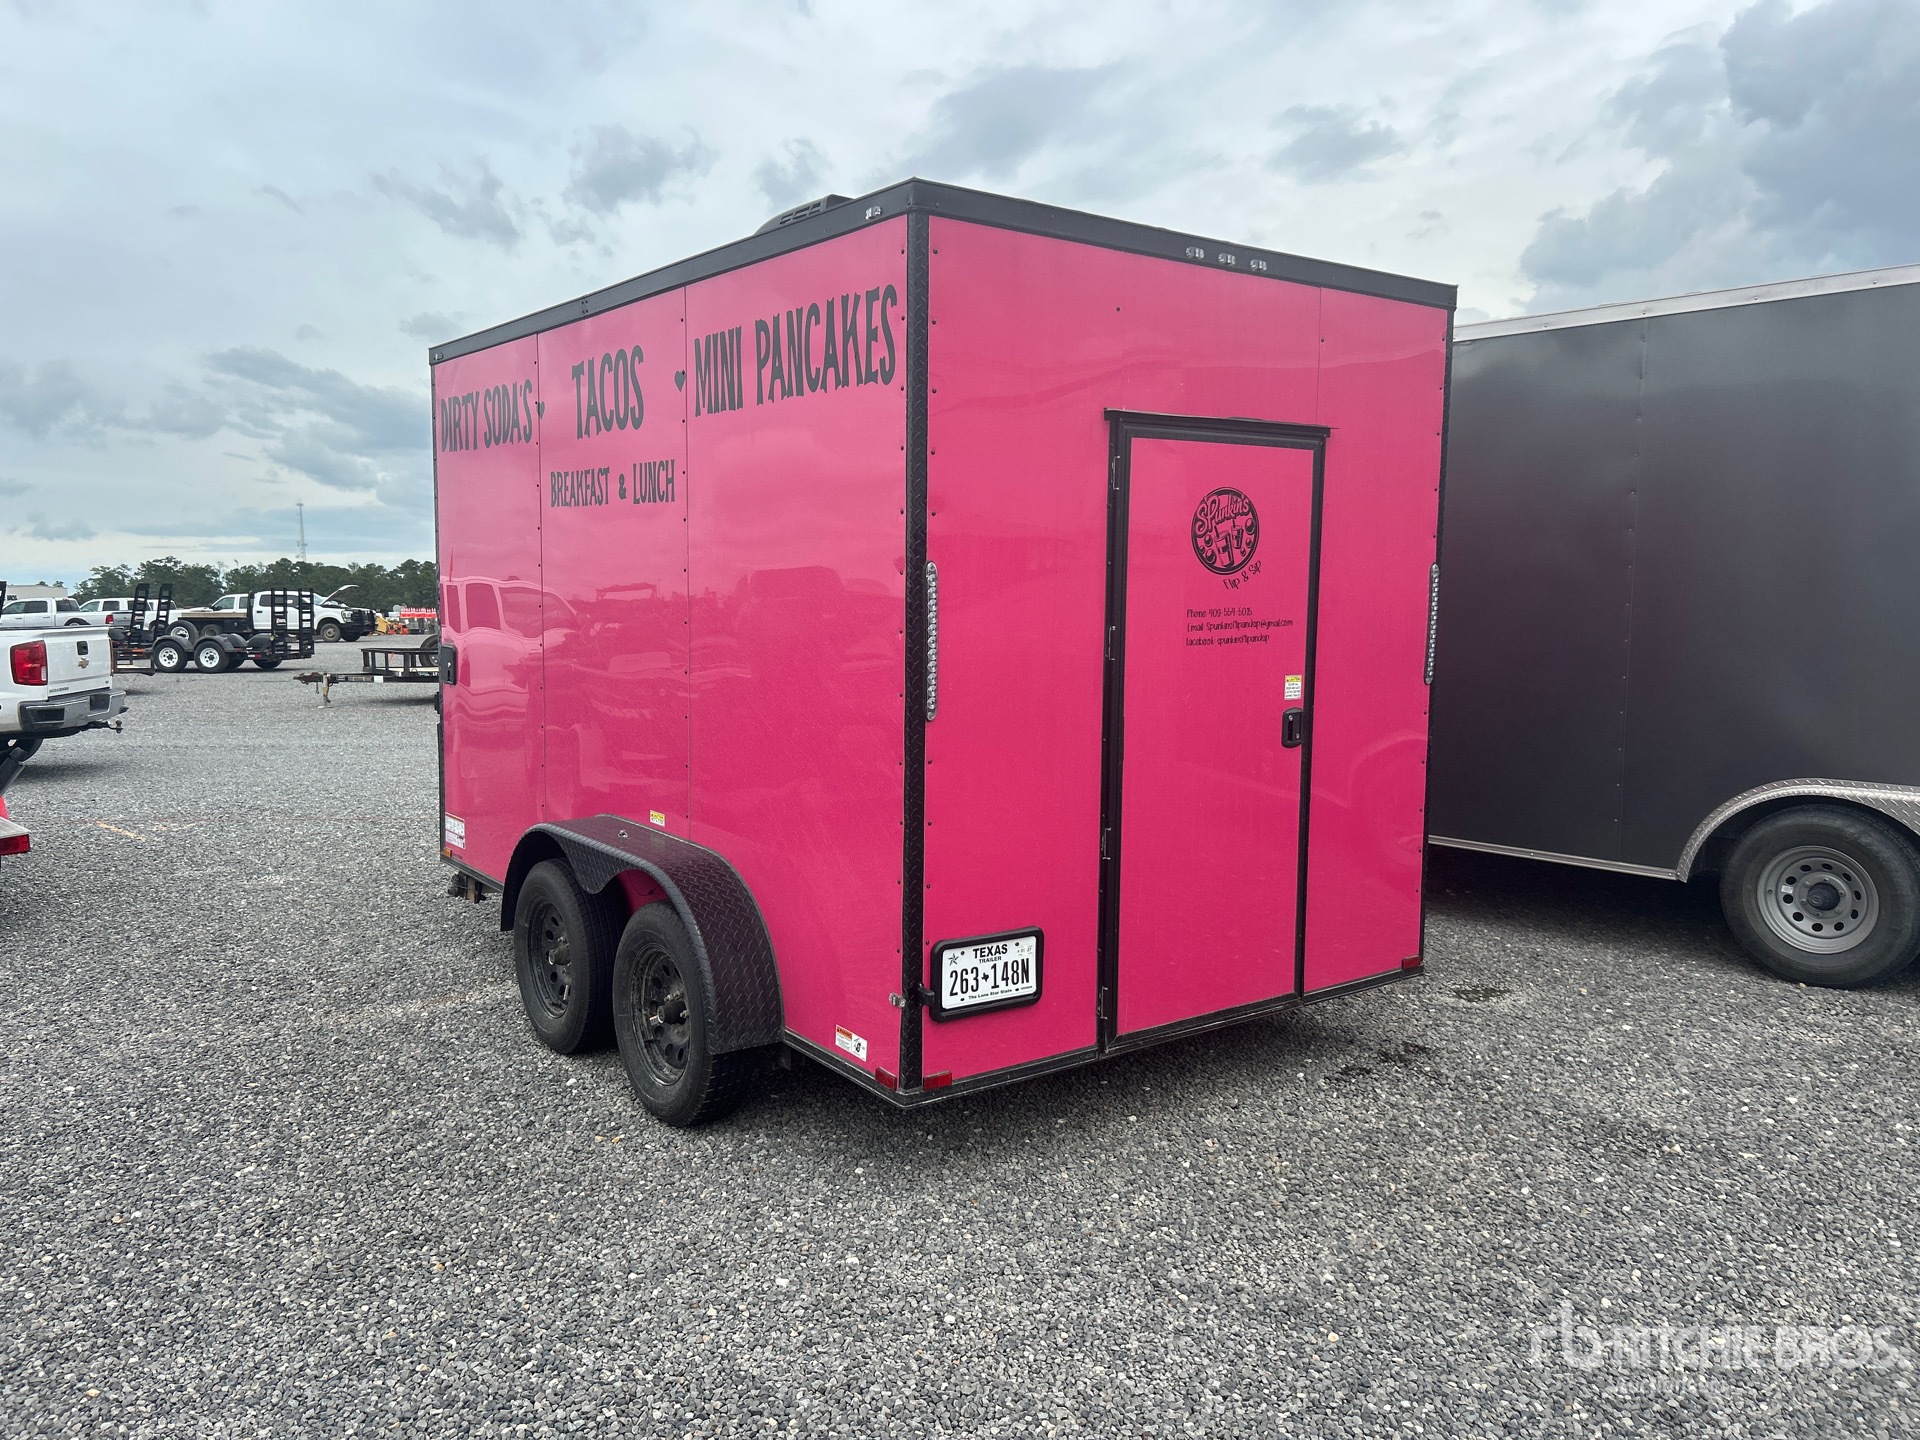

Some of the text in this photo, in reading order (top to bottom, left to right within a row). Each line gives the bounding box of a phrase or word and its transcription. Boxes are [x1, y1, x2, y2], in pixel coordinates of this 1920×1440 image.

[440, 284, 898, 453] DIRTY SODA'S TACOS MINI PANCAKES
[550, 458, 676, 509] BREAKFAST & LUNCH
[1241, 570, 1249, 583] &
[972, 943, 1008, 959] TEXAS
[978, 955, 1002, 964] TRAILER
